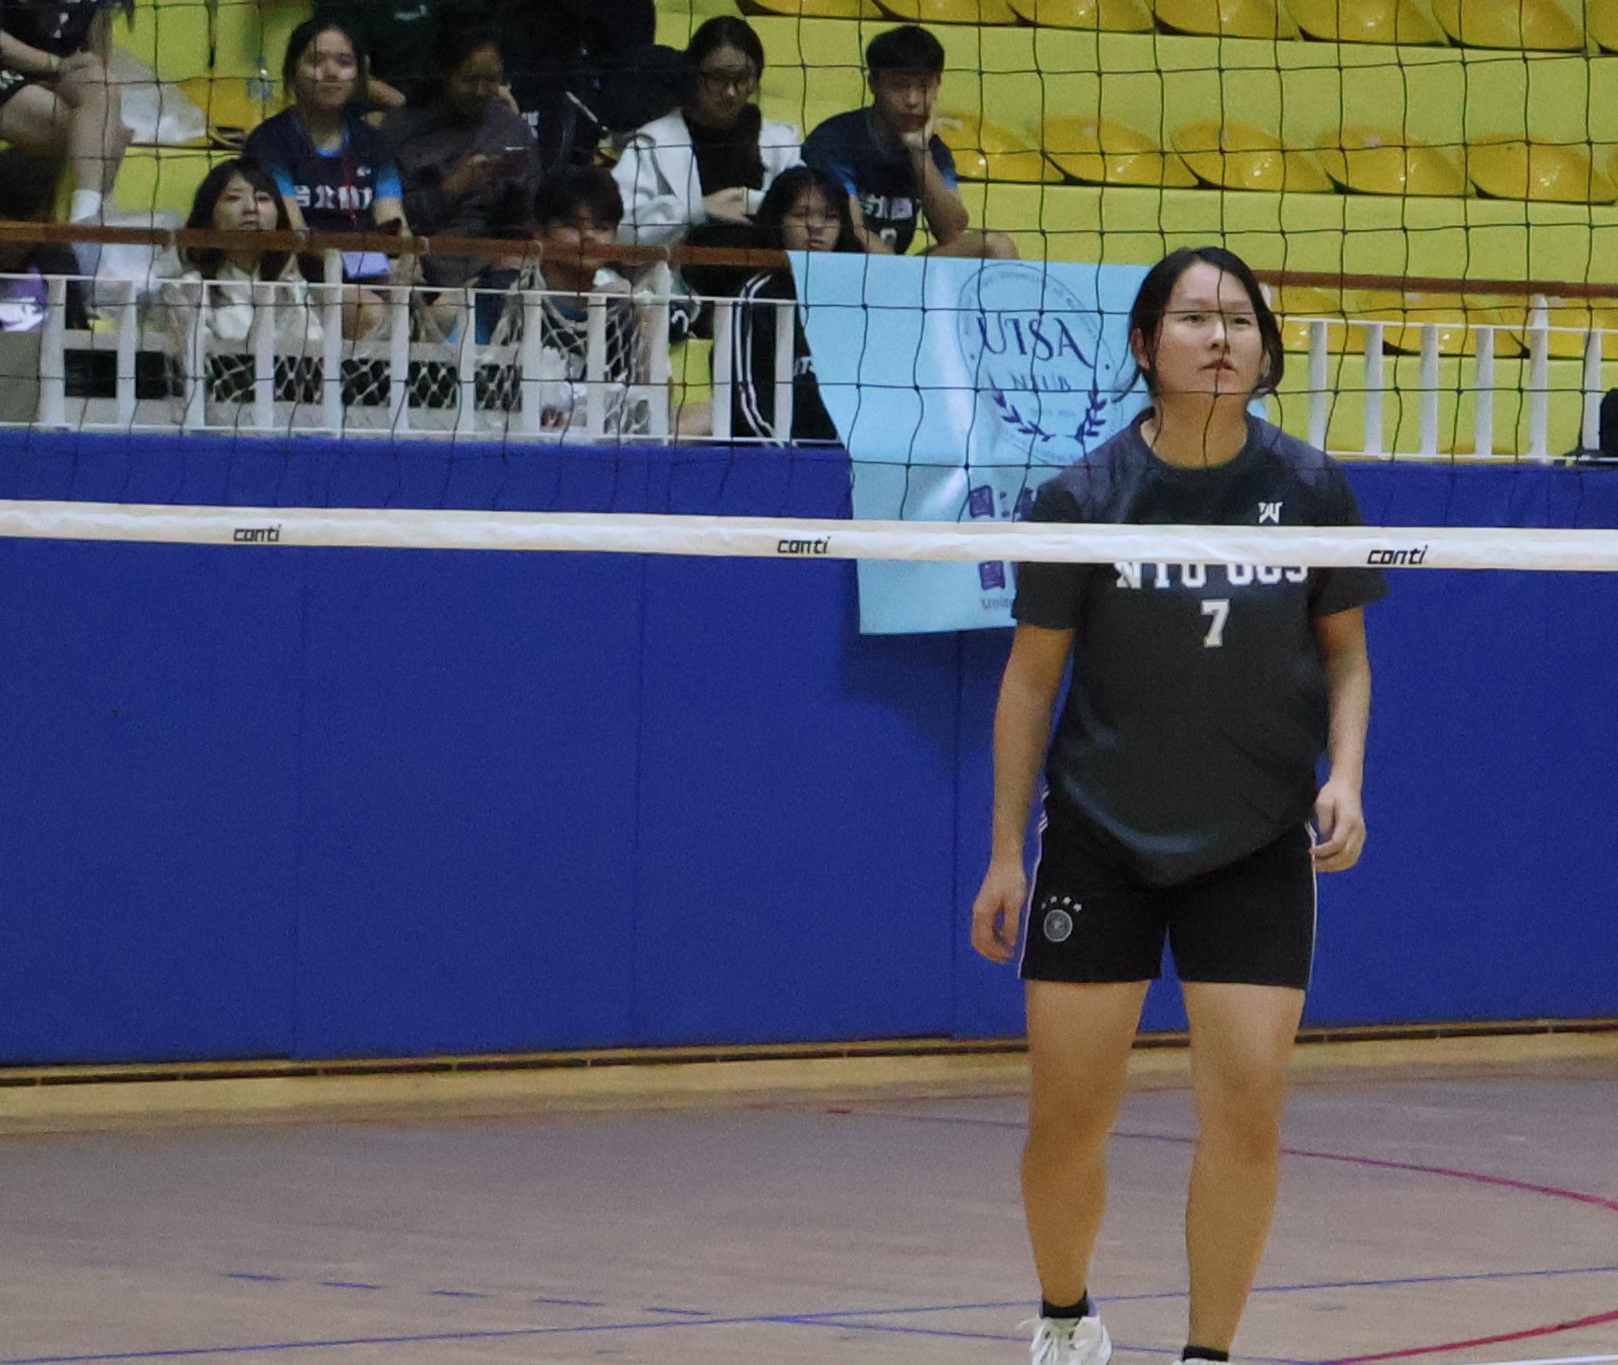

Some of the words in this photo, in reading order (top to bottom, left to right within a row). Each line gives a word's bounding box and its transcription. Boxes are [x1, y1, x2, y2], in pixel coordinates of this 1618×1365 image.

[233, 523, 282, 543] conti
[776, 535, 831, 555] conti
[1366, 544, 1429, 566] conti
[1200, 597, 1231, 648] 7
